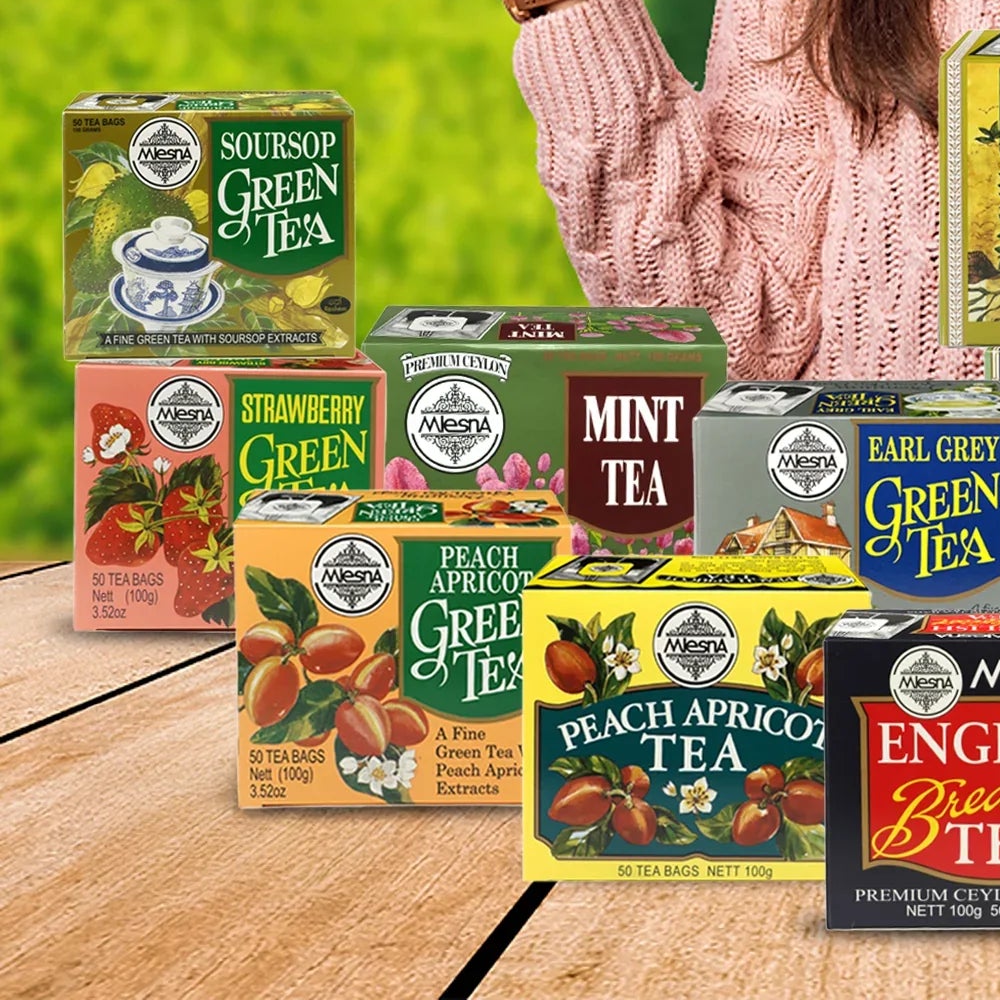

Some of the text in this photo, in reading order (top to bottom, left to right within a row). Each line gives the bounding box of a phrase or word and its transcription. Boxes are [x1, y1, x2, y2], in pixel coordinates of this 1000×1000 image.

[84, 118, 100, 126] TEA
[102, 118, 125, 126] BAGS
[221, 131, 336, 160] SOURSOP
[217, 162, 339, 245] GREEN
[255, 211, 335, 259] TEA
[406, 354, 507, 376] PREMIUM CEYLON
[242, 393, 364, 424] STRAWBERRY
[583, 396, 684, 443] MINT
[868, 436, 999, 462] EARL GREY
[239, 429, 368, 504] GREEN
[601, 460, 668, 506] TEA
[864, 471, 1000, 563] GREEN
[440, 546, 518, 568] PEACH
[906, 522, 995, 579] TEA
[92, 574, 164, 586] 50 TEA BAGS
[430, 571, 534, 593] APRICOT
[92, 590, 158, 605] Nett (100g)
[92, 606, 126, 618] 3.52oz
[436, 727, 486, 740] A Fine
[557, 698, 825, 752] PEACH APRICOT
[251, 749, 325, 764] 50 TEA BAGS
[436, 745, 513, 759] Green Tea
[640, 733, 746, 772] TEA
[250, 767, 313, 783] Nett (100g)
[436, 764, 481, 777] Peach
[251, 785, 286, 798] 3.52oz
[436, 782, 499, 794] Extracts
[618, 865, 773, 879] 50 TEA BAGS NETT 100g
[856, 888, 947, 901] PREMIUM
[906, 905, 943, 917] NETT
[950, 905, 982, 919] 100g
